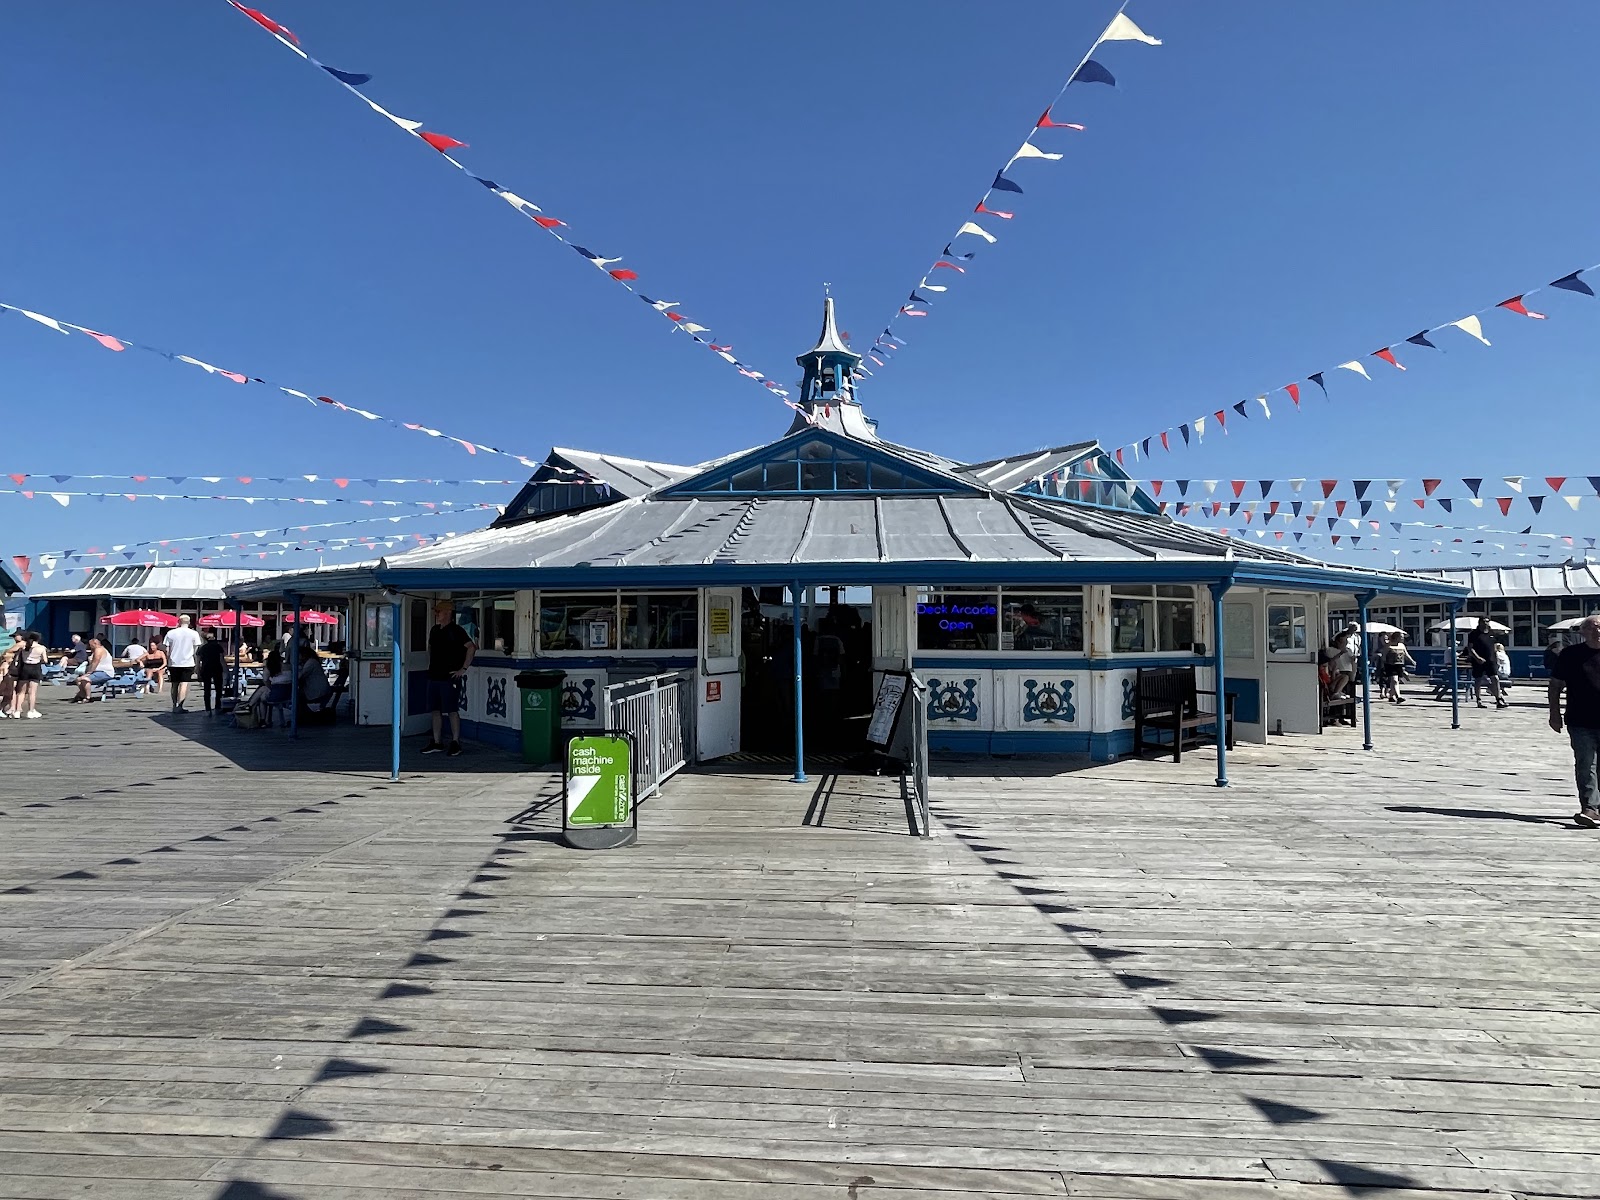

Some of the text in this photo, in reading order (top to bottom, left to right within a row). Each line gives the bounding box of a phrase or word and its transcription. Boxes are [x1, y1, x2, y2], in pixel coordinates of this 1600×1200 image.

[916, 604, 997, 615] Deck Arcade
[939, 619, 974, 632] Open
[572, 746, 596, 757] cash
[572, 755, 614, 765] machine
[572, 764, 601, 774] inside
